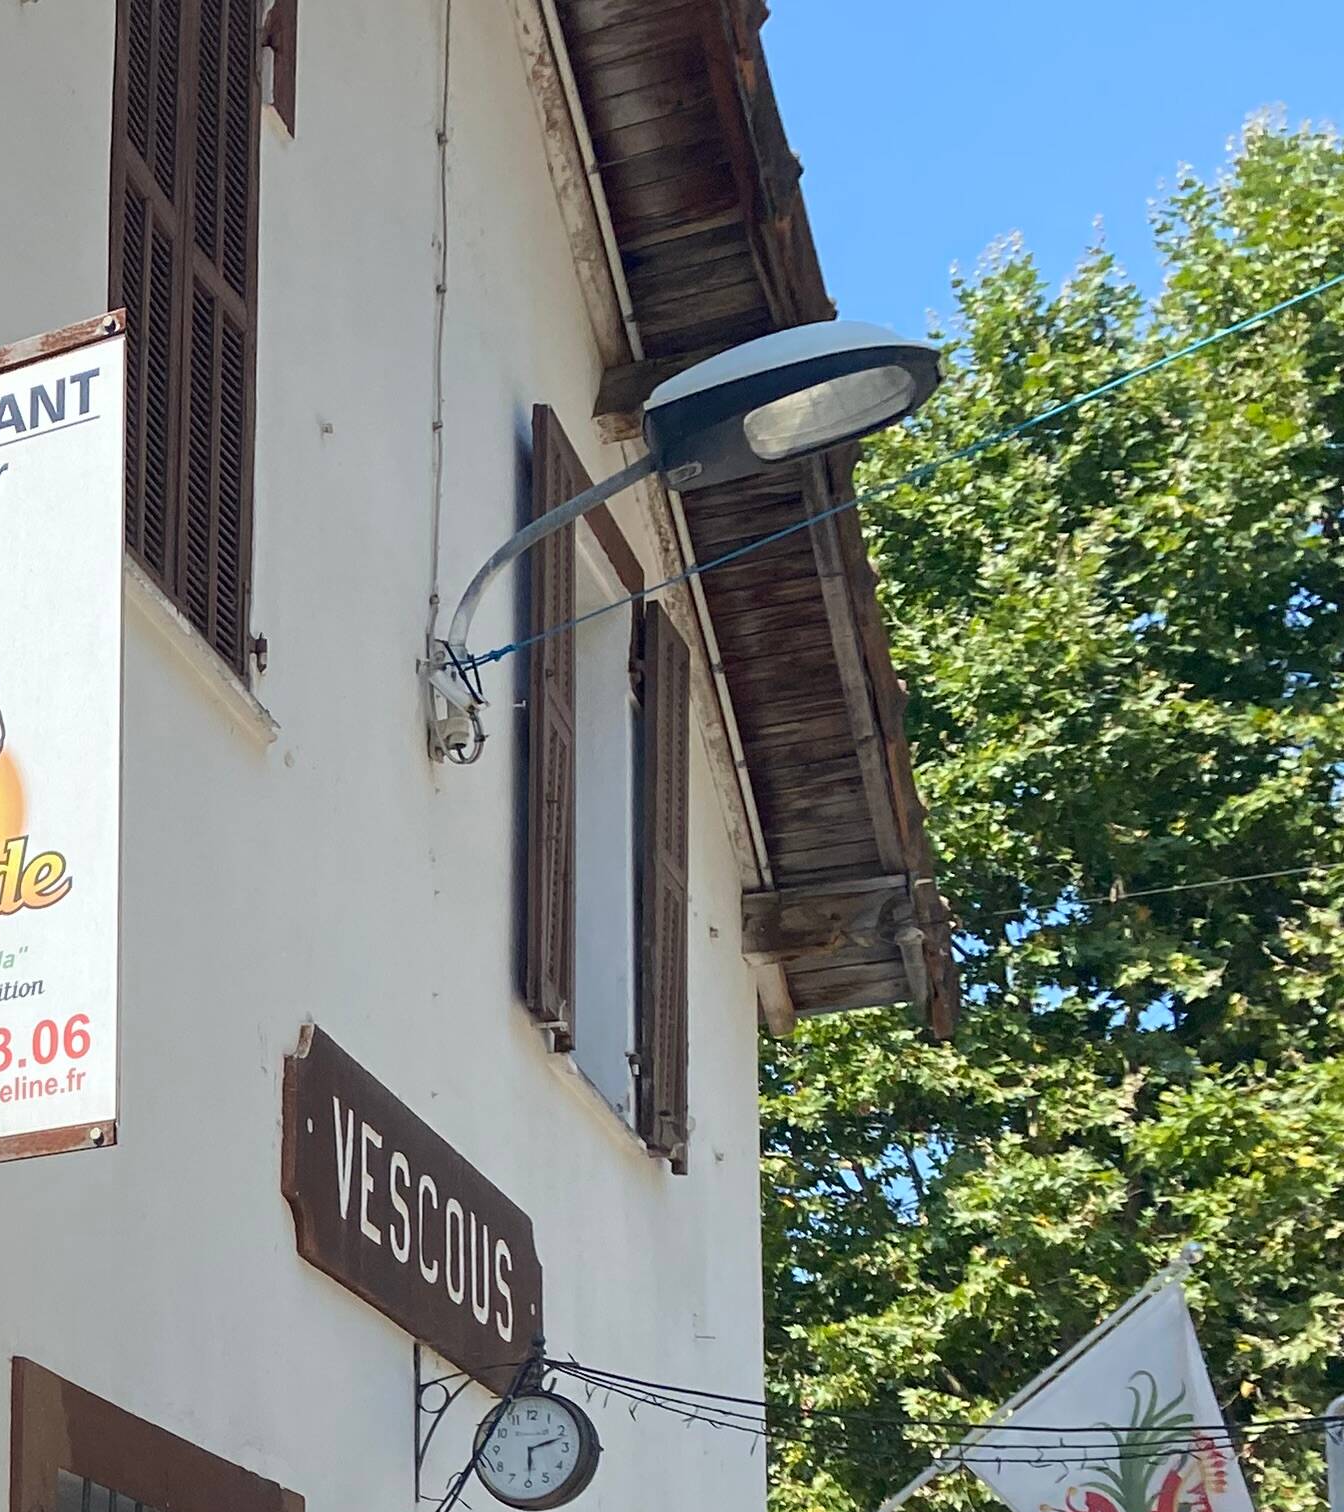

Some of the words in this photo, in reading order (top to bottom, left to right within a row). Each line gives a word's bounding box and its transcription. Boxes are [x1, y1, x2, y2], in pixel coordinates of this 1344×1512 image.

[332, 1096, 513, 1343] VESCOUS
[527, 1410, 537, 1421] 12
[497, 1428, 507, 1438] 10
[557, 1425, 567, 1436] 2
[493, 1445, 500, 1455] 9
[561, 1442, 569, 1453] 3
[496, 1461, 504, 1472] 8
[556, 1461, 563, 1470] 4
[508, 1474, 516, 1484] 7
[524, 1477, 533, 1488] 6
[542, 1472, 550, 1483] 5
